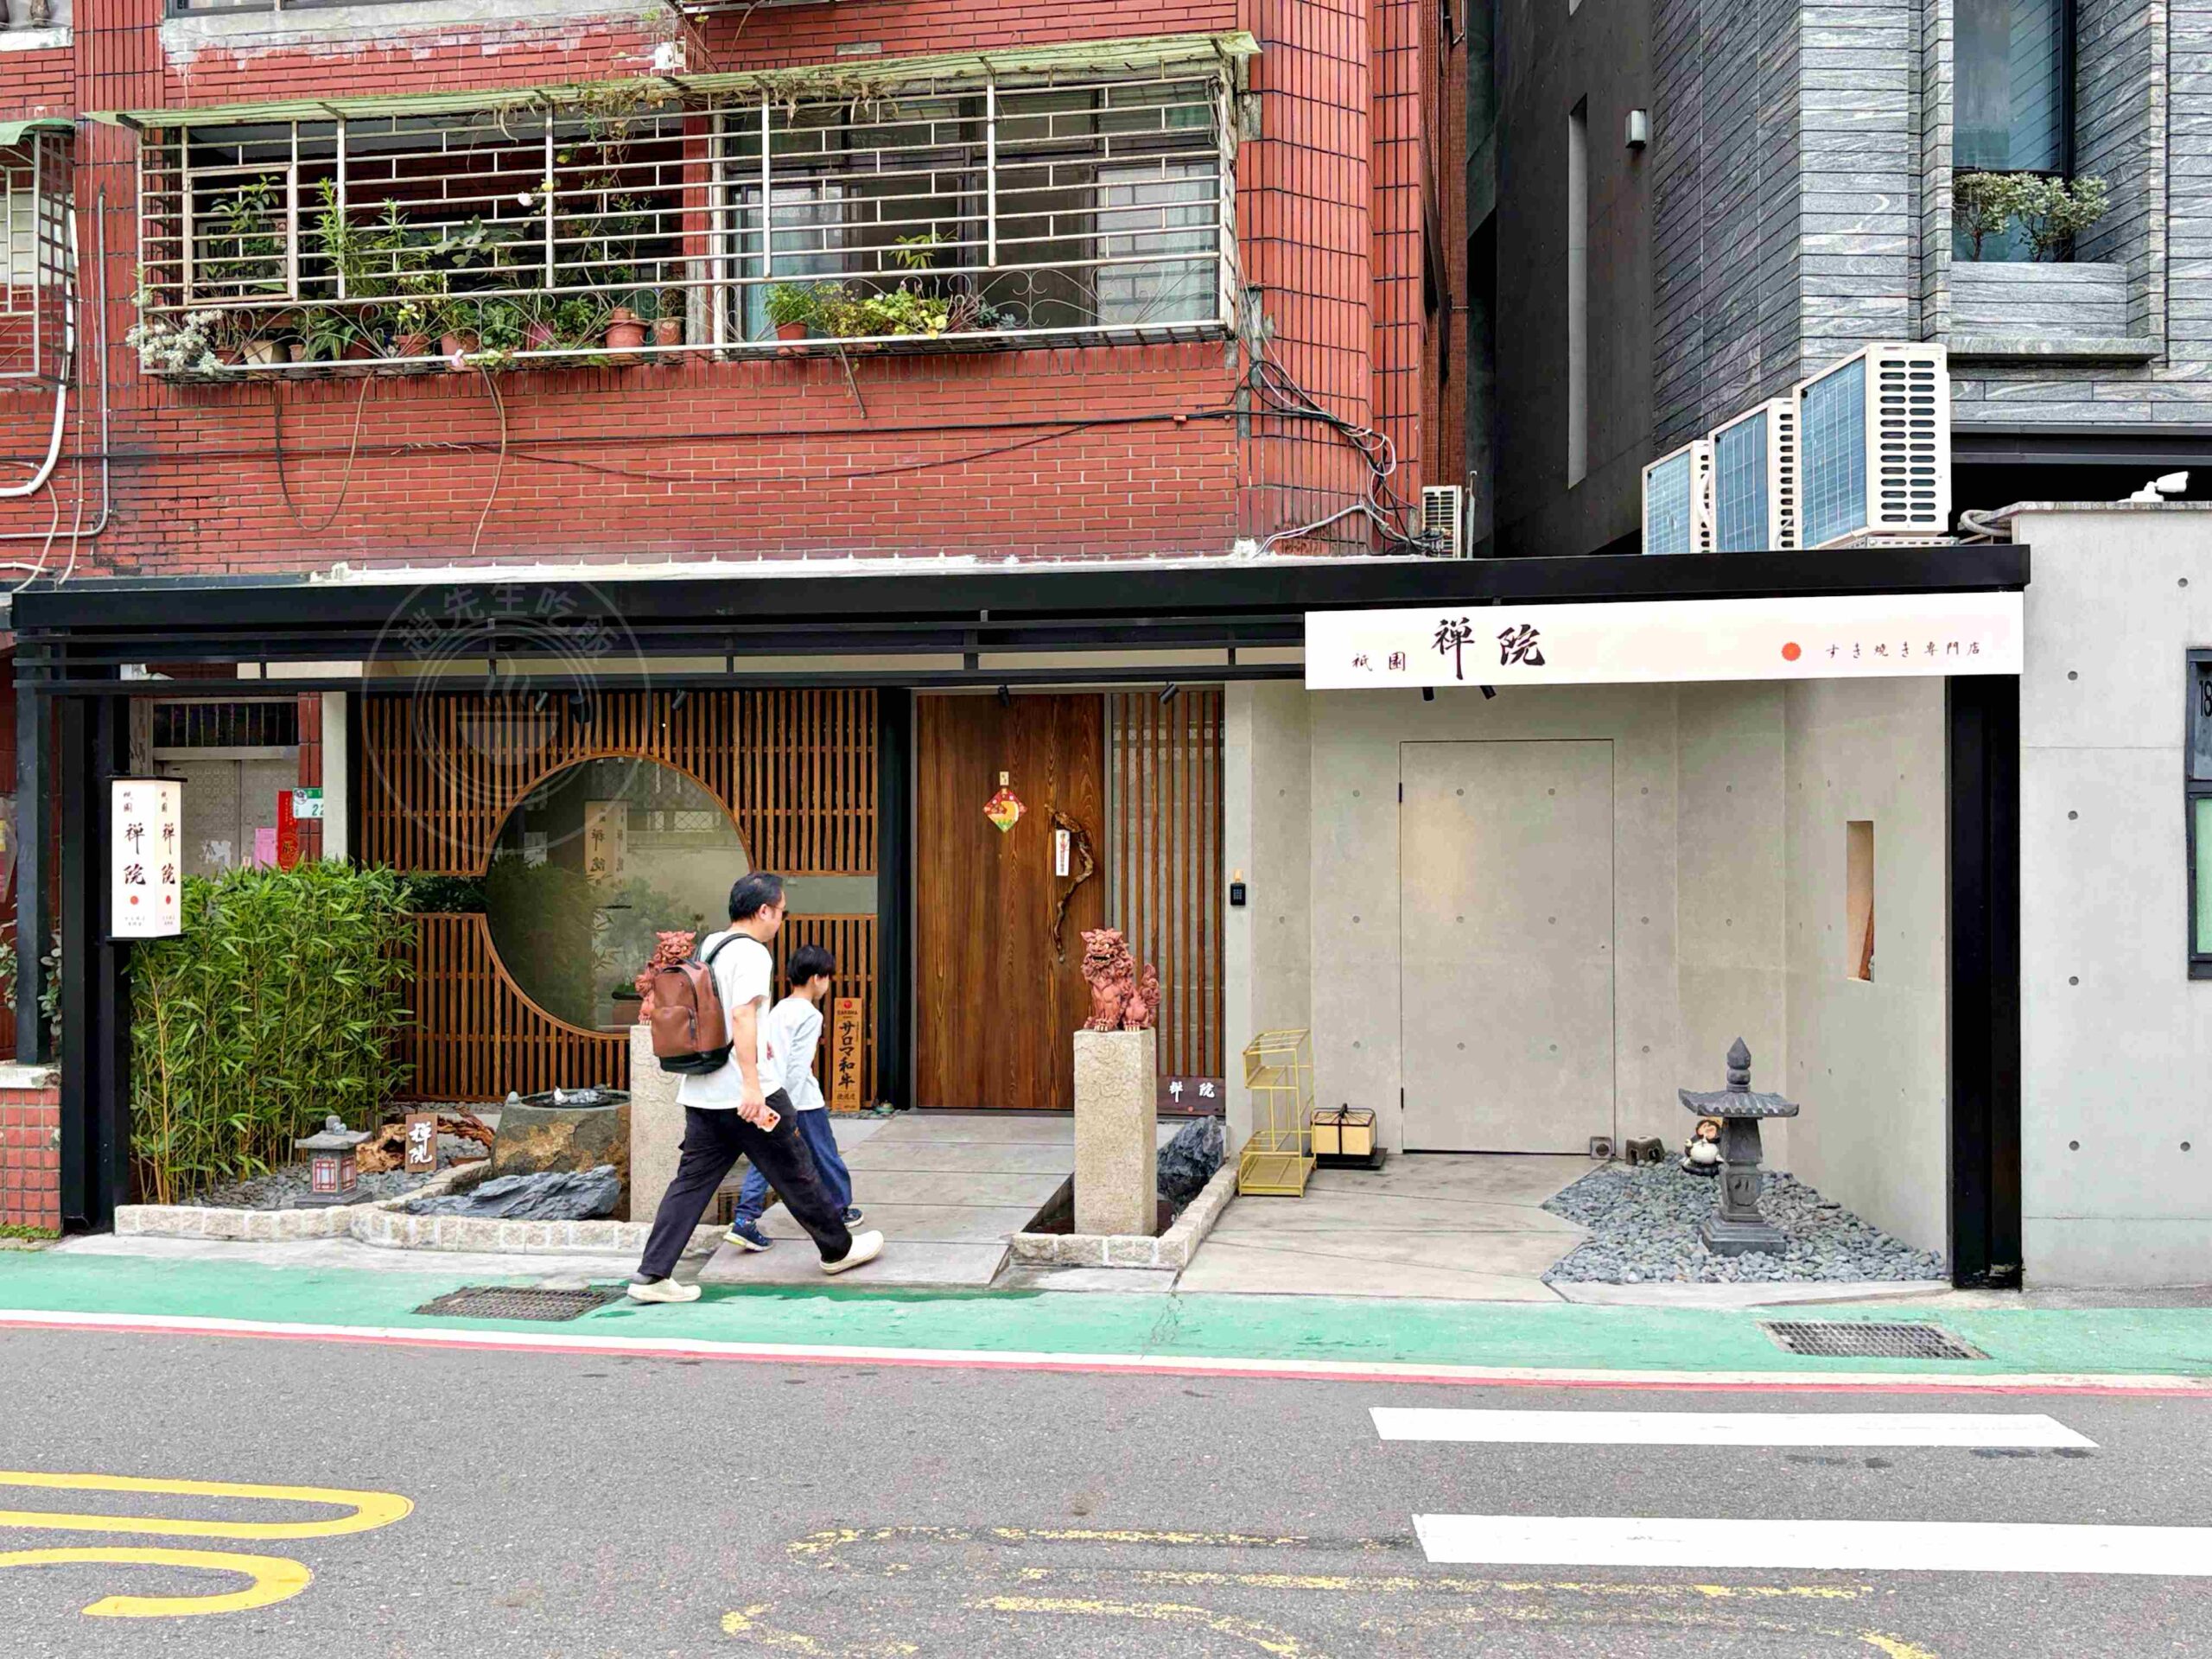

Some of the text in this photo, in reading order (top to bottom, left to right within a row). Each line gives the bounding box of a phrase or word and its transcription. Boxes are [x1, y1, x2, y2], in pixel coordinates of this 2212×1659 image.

[838, 1020, 855, 1090] サロマ和牛
